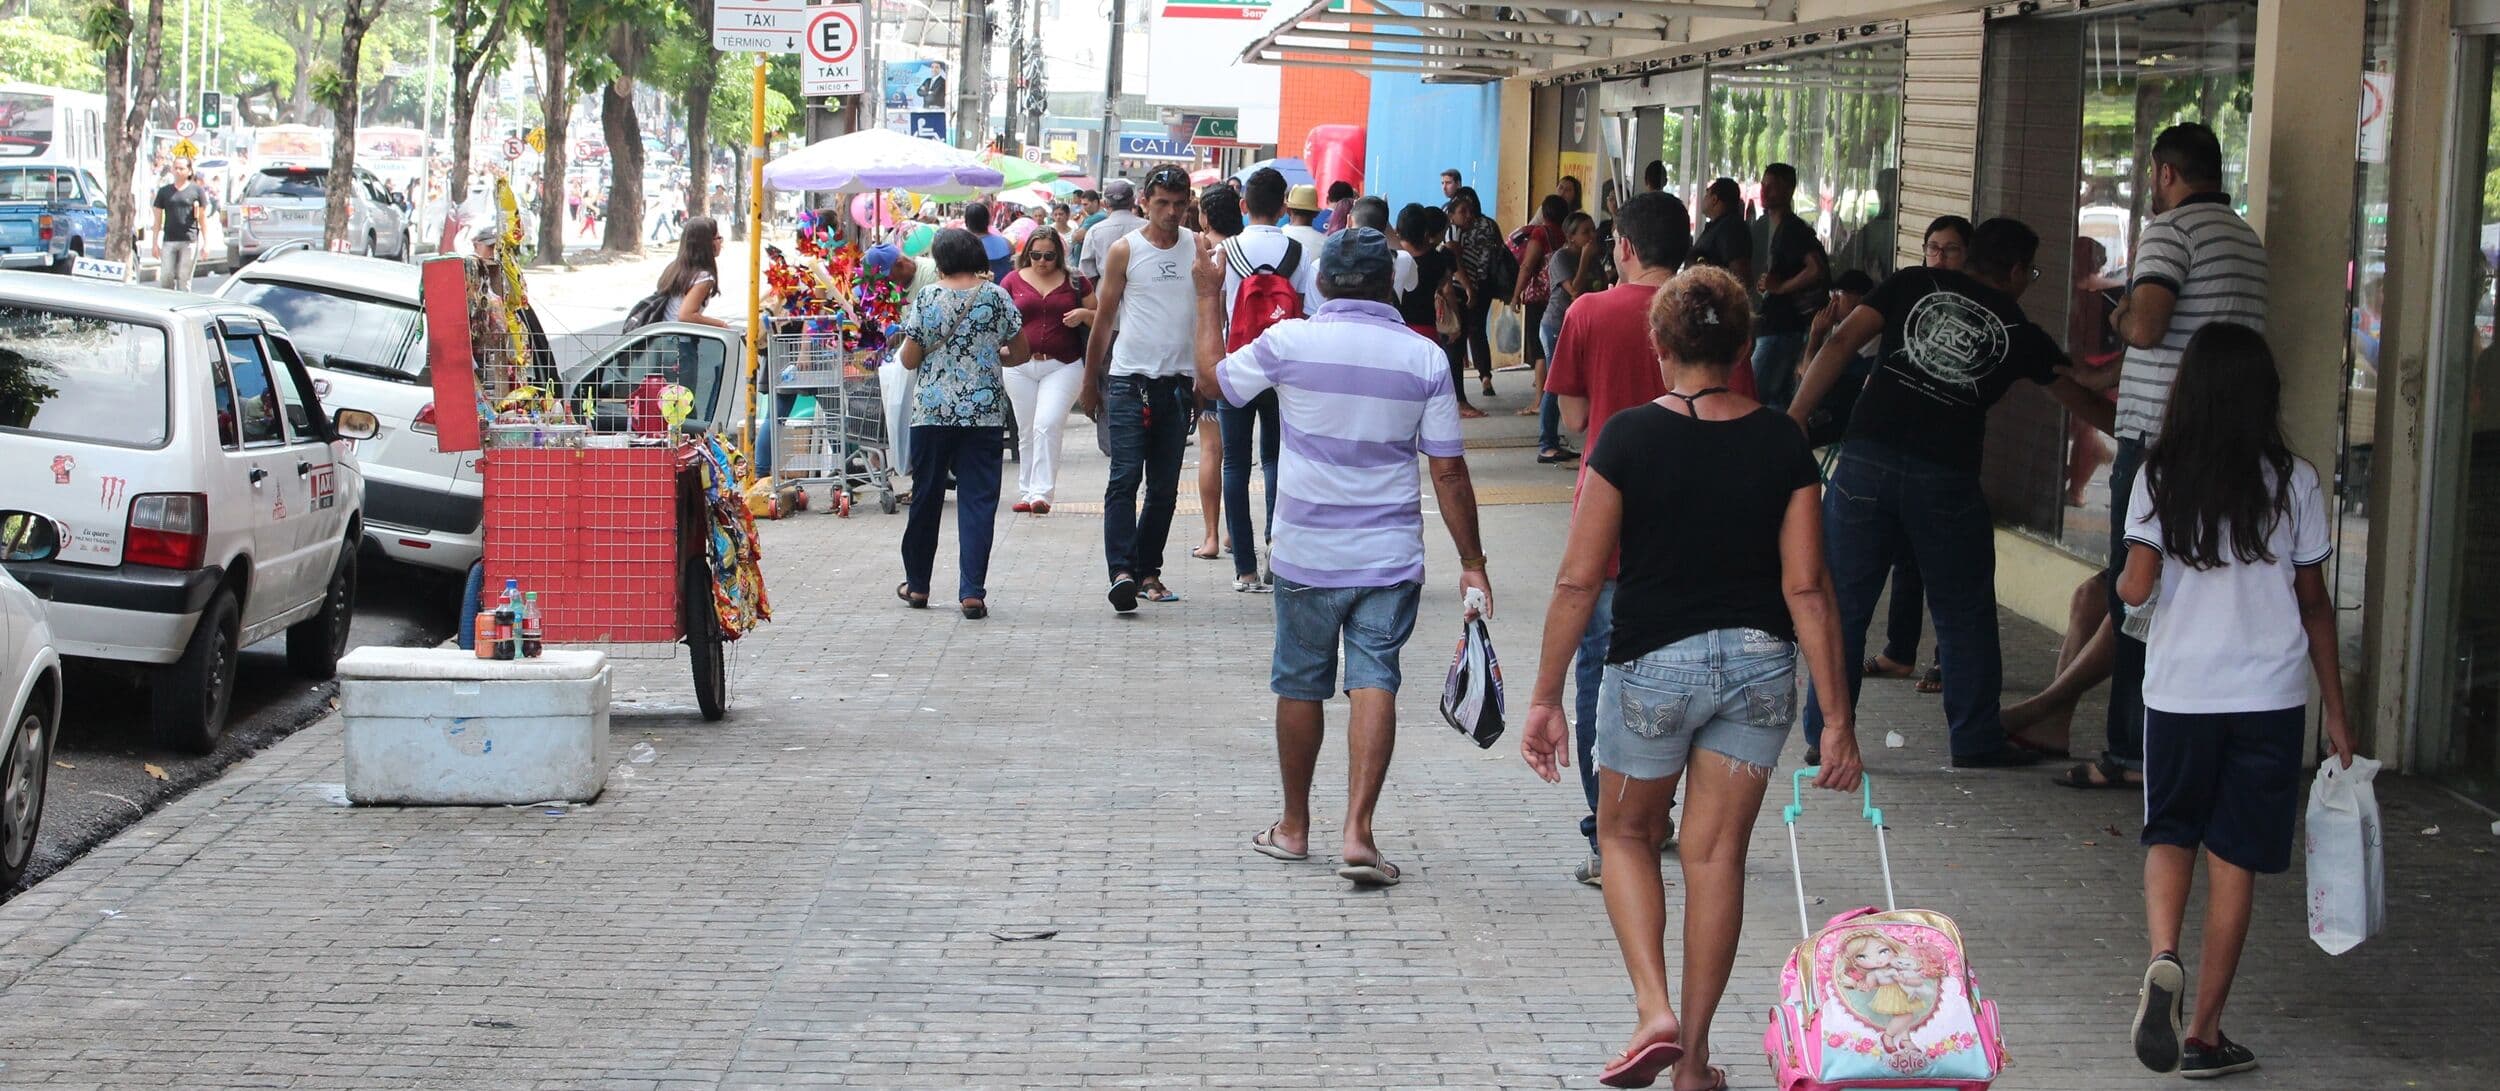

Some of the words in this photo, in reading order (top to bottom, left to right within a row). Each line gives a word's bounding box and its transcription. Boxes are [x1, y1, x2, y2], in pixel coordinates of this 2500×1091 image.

[744, 12, 776, 27] TÁXI
[721, 34, 771, 48] TÉRMINO
[823, 23, 841, 51] E
[818, 65, 849, 77] TÁXI
[817, 83, 841, 91] INÍCIO
[179, 122, 194, 132] 20
[78, 261, 124, 276] TAXI
[1892, 1054, 1924, 1069] Jolie
